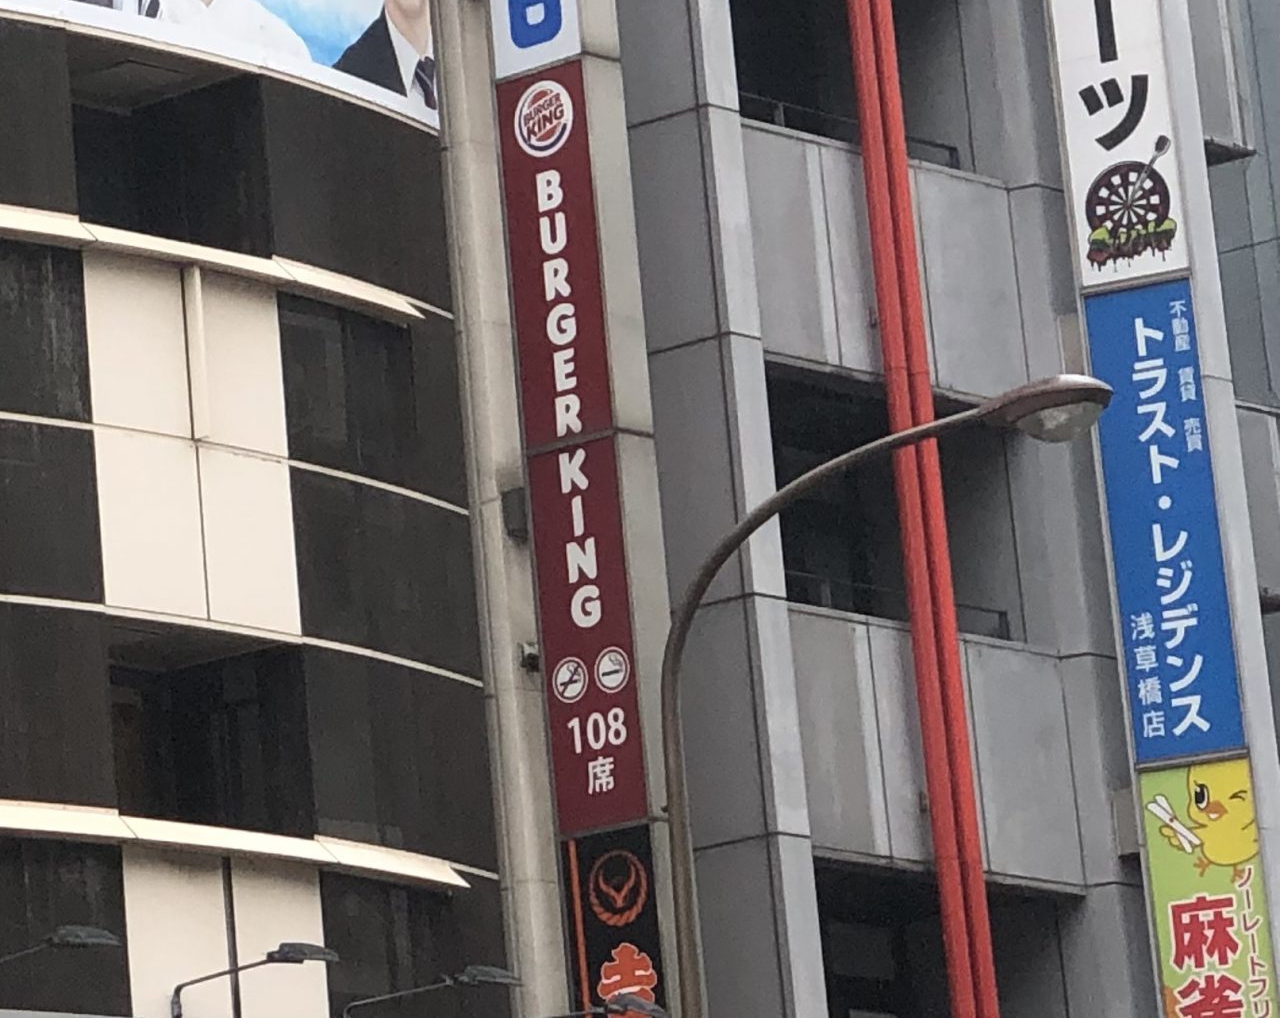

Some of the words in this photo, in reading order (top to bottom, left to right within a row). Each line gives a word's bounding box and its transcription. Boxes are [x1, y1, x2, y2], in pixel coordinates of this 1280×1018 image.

[523, 92, 562, 127] BURGER
[527, 103, 565, 143] KING
[535, 169, 583, 437] BURGER
[557, 448, 602, 628] KING
[1130, 612, 1166, 738] 浅草橋店
